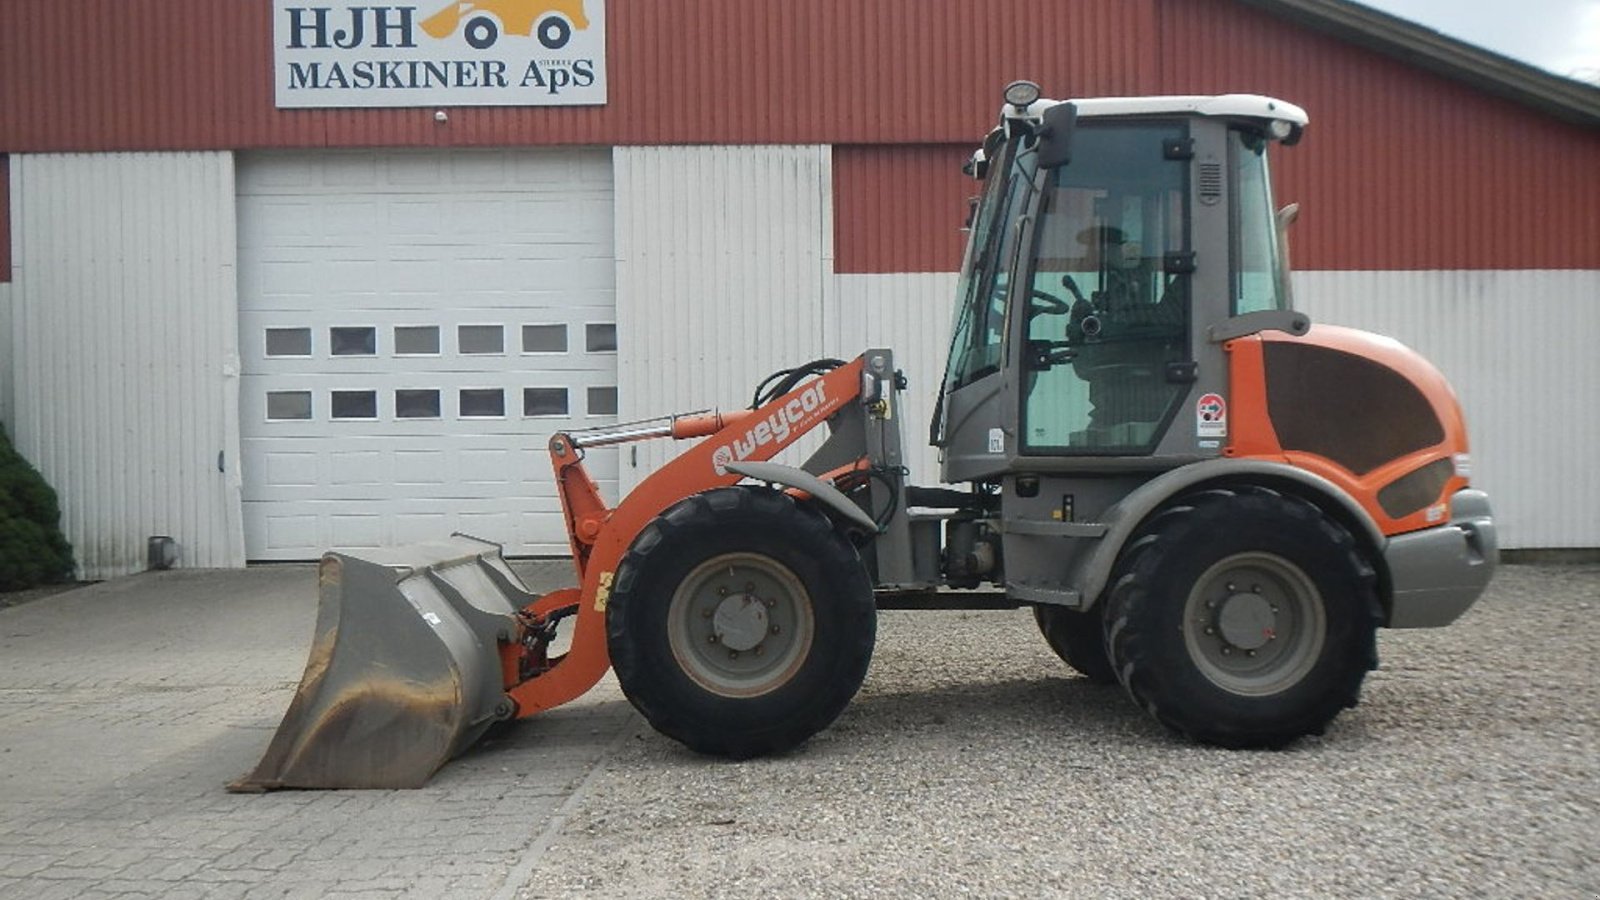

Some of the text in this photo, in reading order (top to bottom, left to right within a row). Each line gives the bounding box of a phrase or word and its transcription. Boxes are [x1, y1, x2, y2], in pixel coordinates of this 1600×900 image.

[285, 7, 417, 49] HJH
[288, 59, 595, 95] MASKINER ApS
[733, 379, 826, 461] weycor
